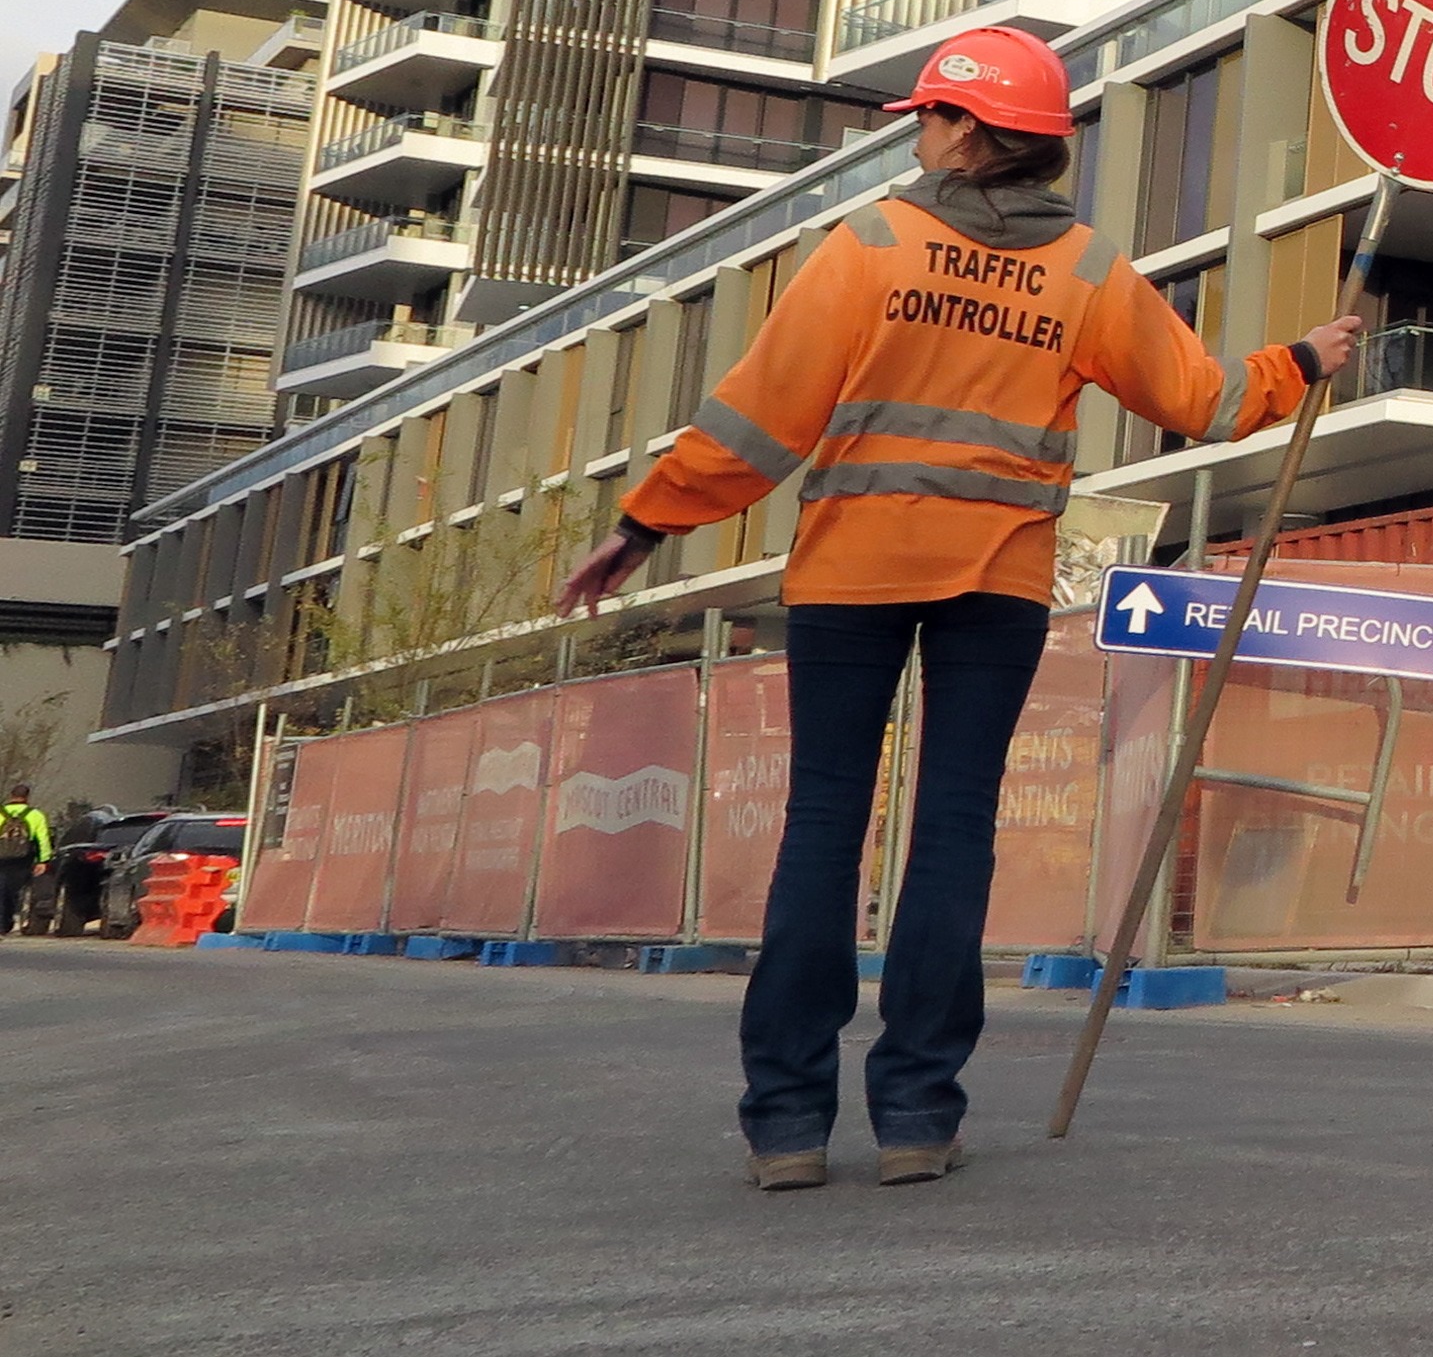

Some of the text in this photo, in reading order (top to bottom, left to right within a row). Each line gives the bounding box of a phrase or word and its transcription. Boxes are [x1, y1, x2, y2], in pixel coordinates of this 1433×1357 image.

[925, 241, 1046, 296] TRAFFIC
[885, 289, 1065, 353] CONTROLLER
[1184, 602, 1289, 635] REAIL
[617, 777, 679, 820] CENTRAL
[728, 800, 776, 837] NOW
